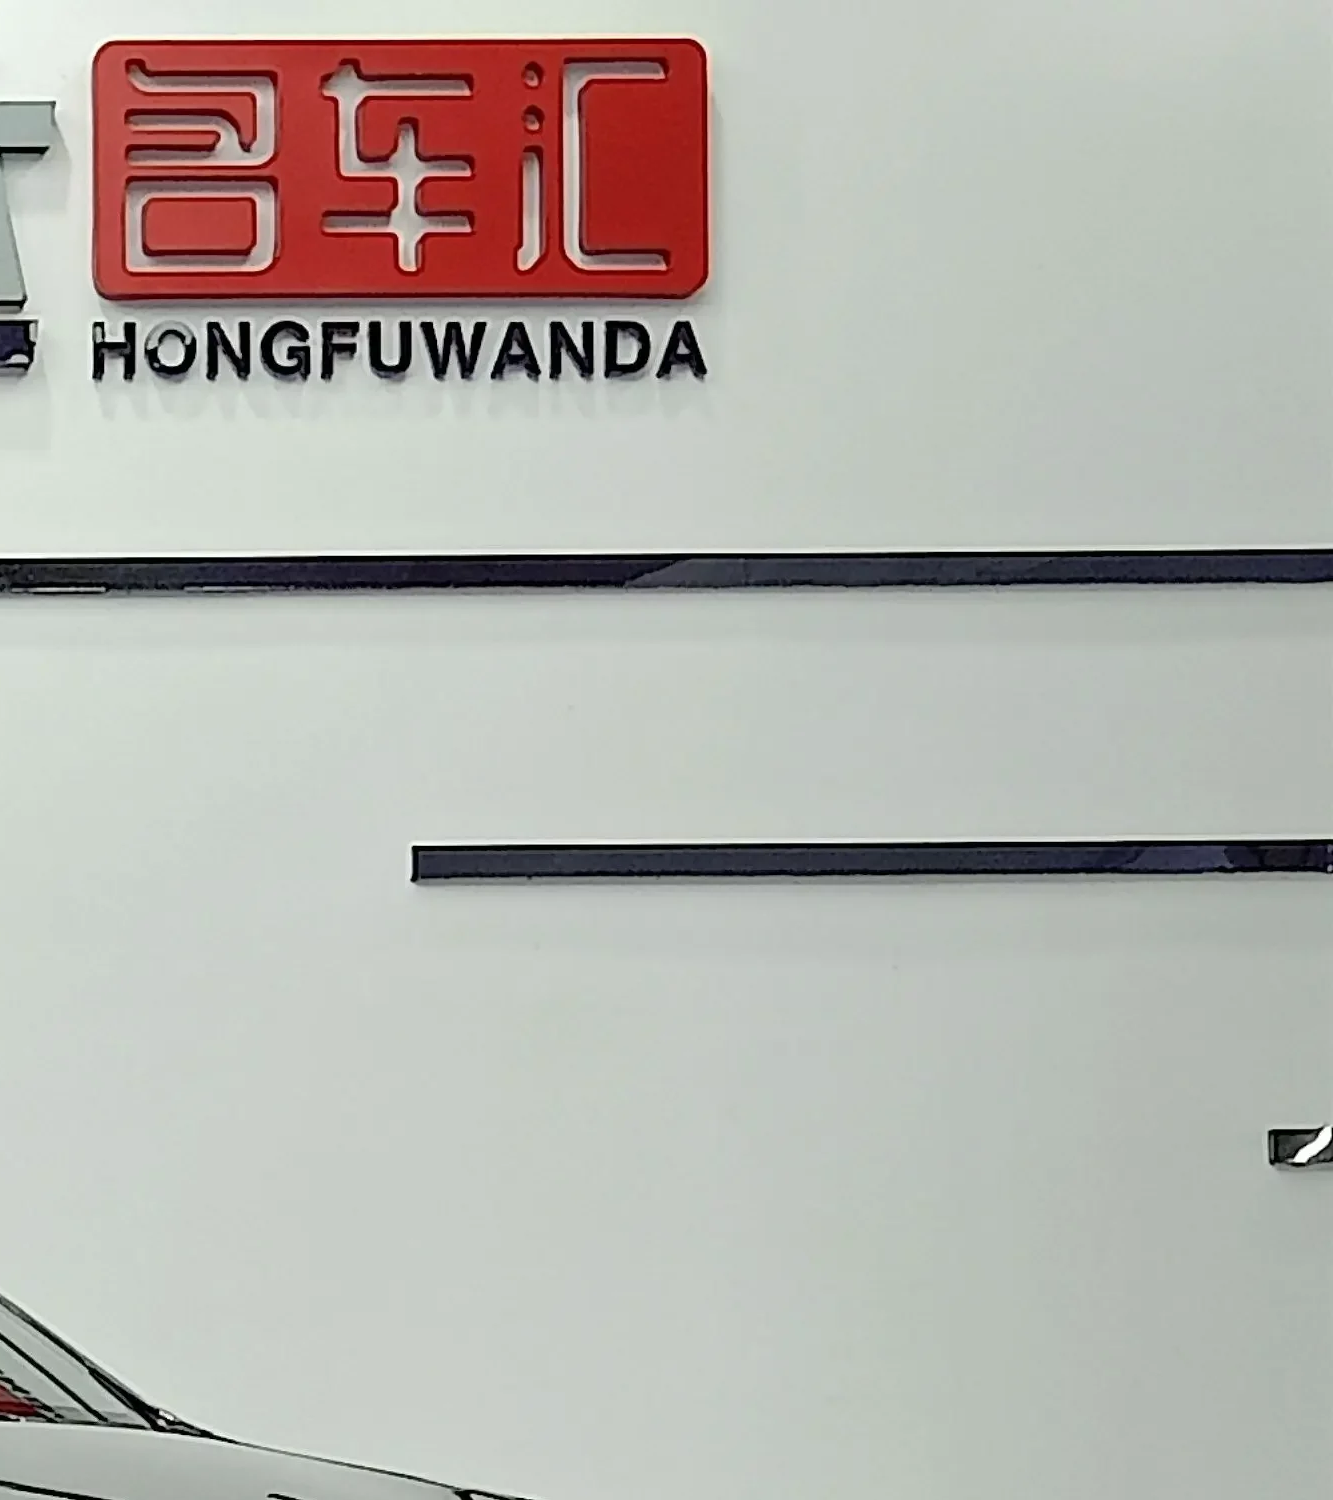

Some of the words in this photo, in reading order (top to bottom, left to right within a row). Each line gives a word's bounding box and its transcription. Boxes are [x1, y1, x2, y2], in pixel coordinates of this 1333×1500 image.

[123, 57, 671, 276] 名车汇
[91, 320, 709, 382] HONGFUWANDA
